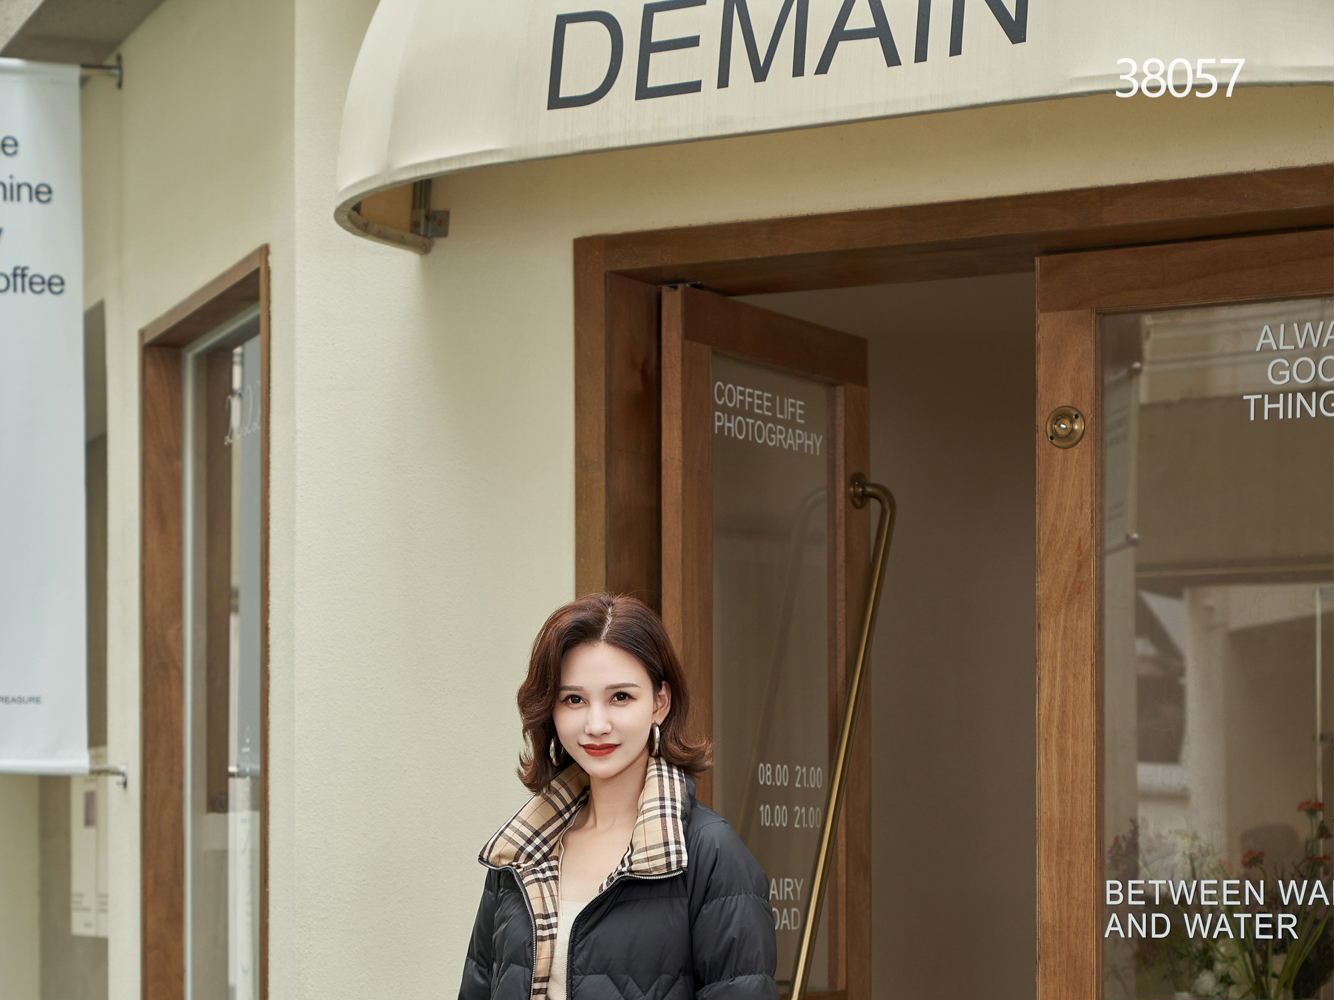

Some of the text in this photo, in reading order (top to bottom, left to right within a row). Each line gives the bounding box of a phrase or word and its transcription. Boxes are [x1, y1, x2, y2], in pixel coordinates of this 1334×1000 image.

[714, 381, 806, 425] COFFEE LIFE
[714, 411, 824, 457] PHOTOGRAPHY
[758, 763, 823, 788] 08.00 21.00
[759, 804, 823, 829] 10.00 21.00
[1105, 880, 1334, 906] BETWEEN WA
[1104, 913, 1299, 940] AND WATER
